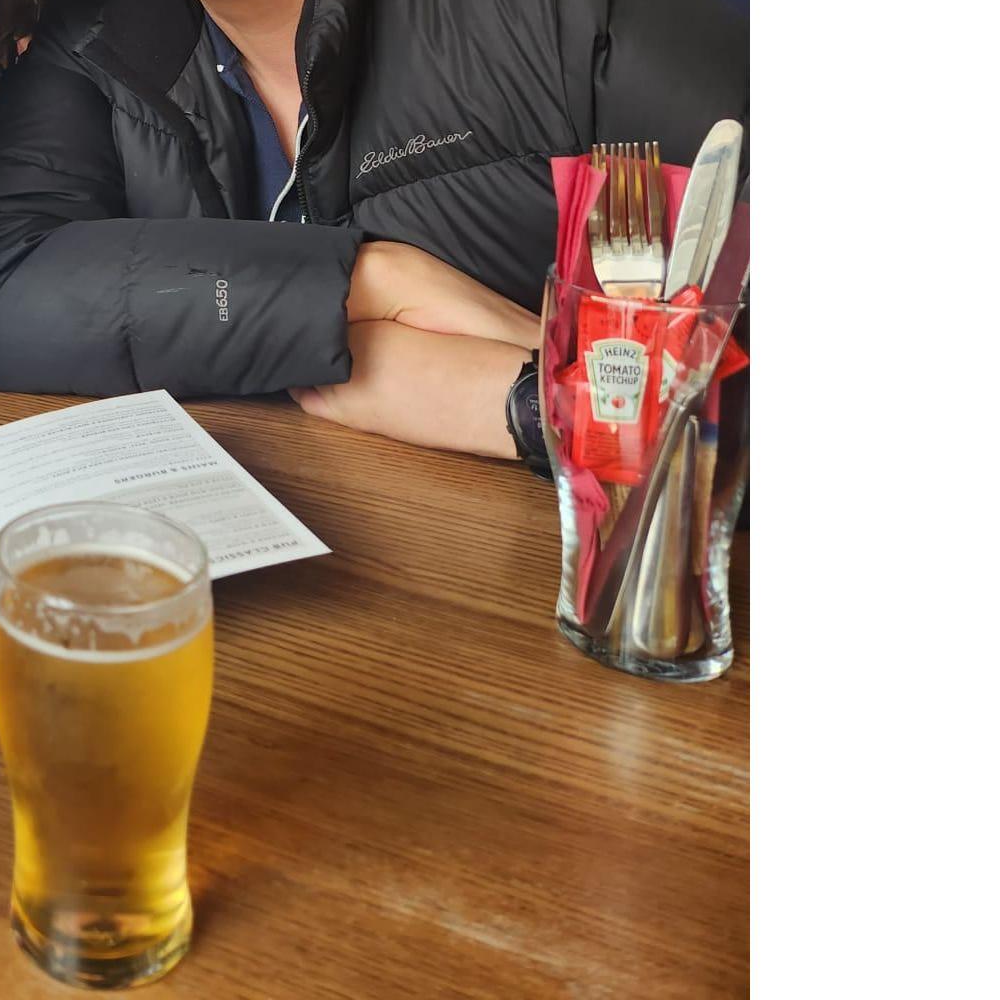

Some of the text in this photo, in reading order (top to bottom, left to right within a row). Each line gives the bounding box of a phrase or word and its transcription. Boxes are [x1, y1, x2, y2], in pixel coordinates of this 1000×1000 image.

[356, 131, 473, 179] Eddie Bauer
[215, 279, 229, 321] EB650
[604, 347, 637, 359] HEINZ
[598, 363, 641, 376] TOMATO
[600, 375, 639, 385] KETCHUP
